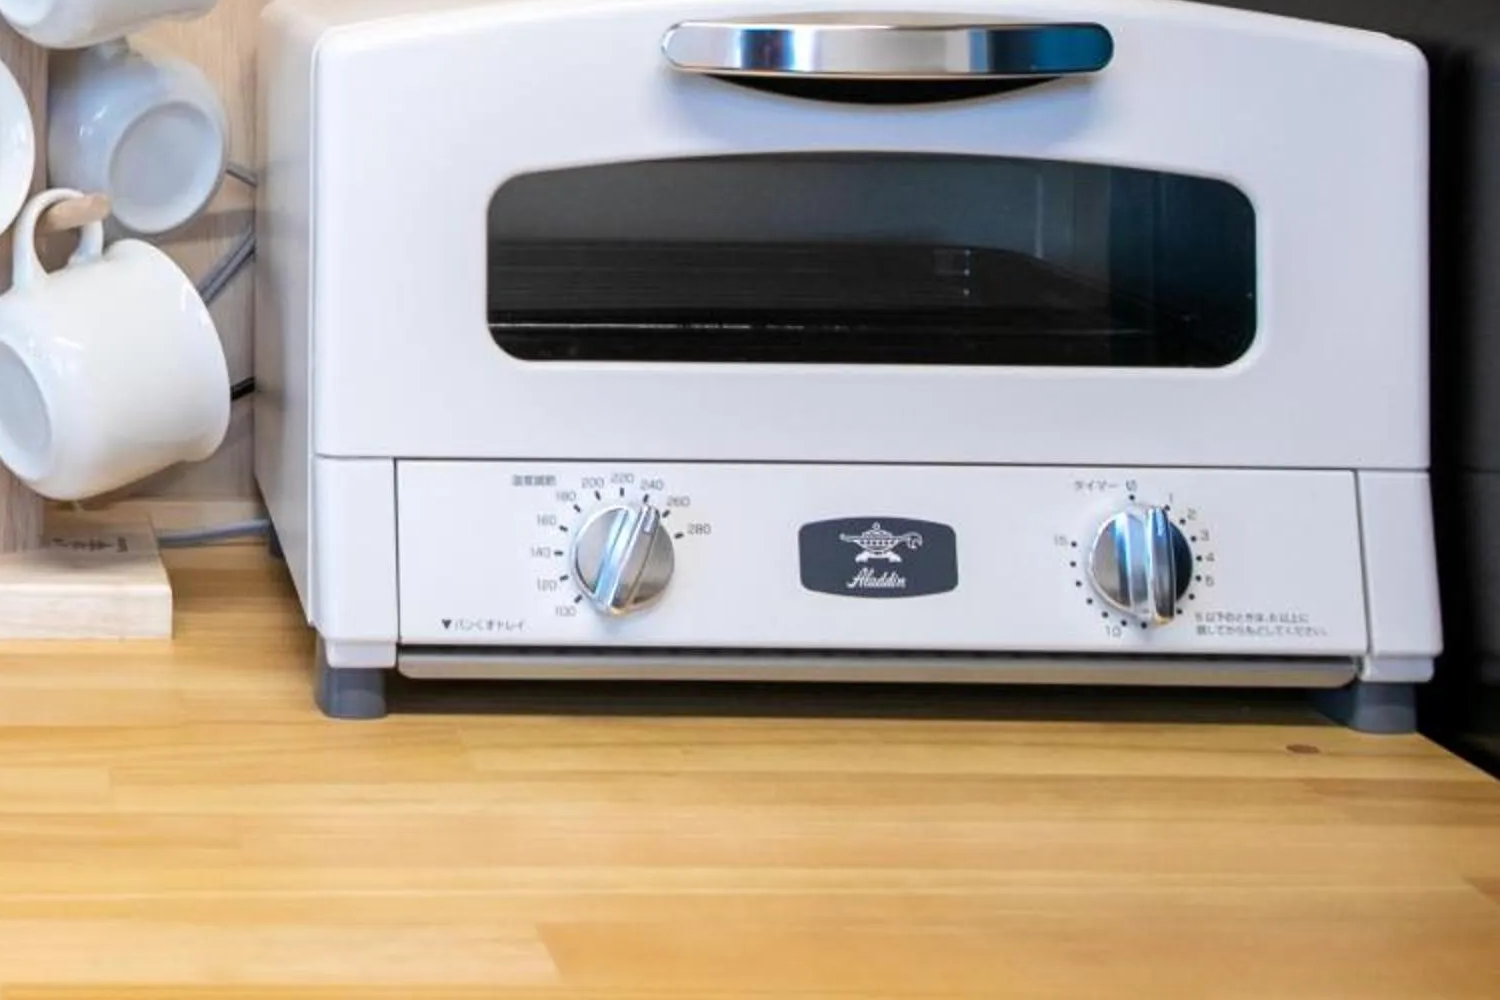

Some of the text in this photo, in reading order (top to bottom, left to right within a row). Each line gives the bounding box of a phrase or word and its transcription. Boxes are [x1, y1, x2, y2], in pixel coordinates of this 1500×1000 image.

[581, 477, 605, 489] 200
[611, 472, 634, 485] 220
[640, 478, 664, 491] 240
[1074, 480, 1118, 491] タイマー
[556, 490, 577, 502] 180
[666, 495, 690, 507] 260
[1187, 508, 1196, 520] 2
[537, 514, 557, 527] 160
[687, 523, 711, 535] 280
[1200, 530, 1209, 541] 3
[531, 546, 551, 558] 140
[1205, 552, 1215, 562] 4
[846, 567, 907, 589] Aladdin
[537, 579, 557, 591] 120
[555, 605, 577, 617] 100
[1105, 625, 1122, 637] 10
